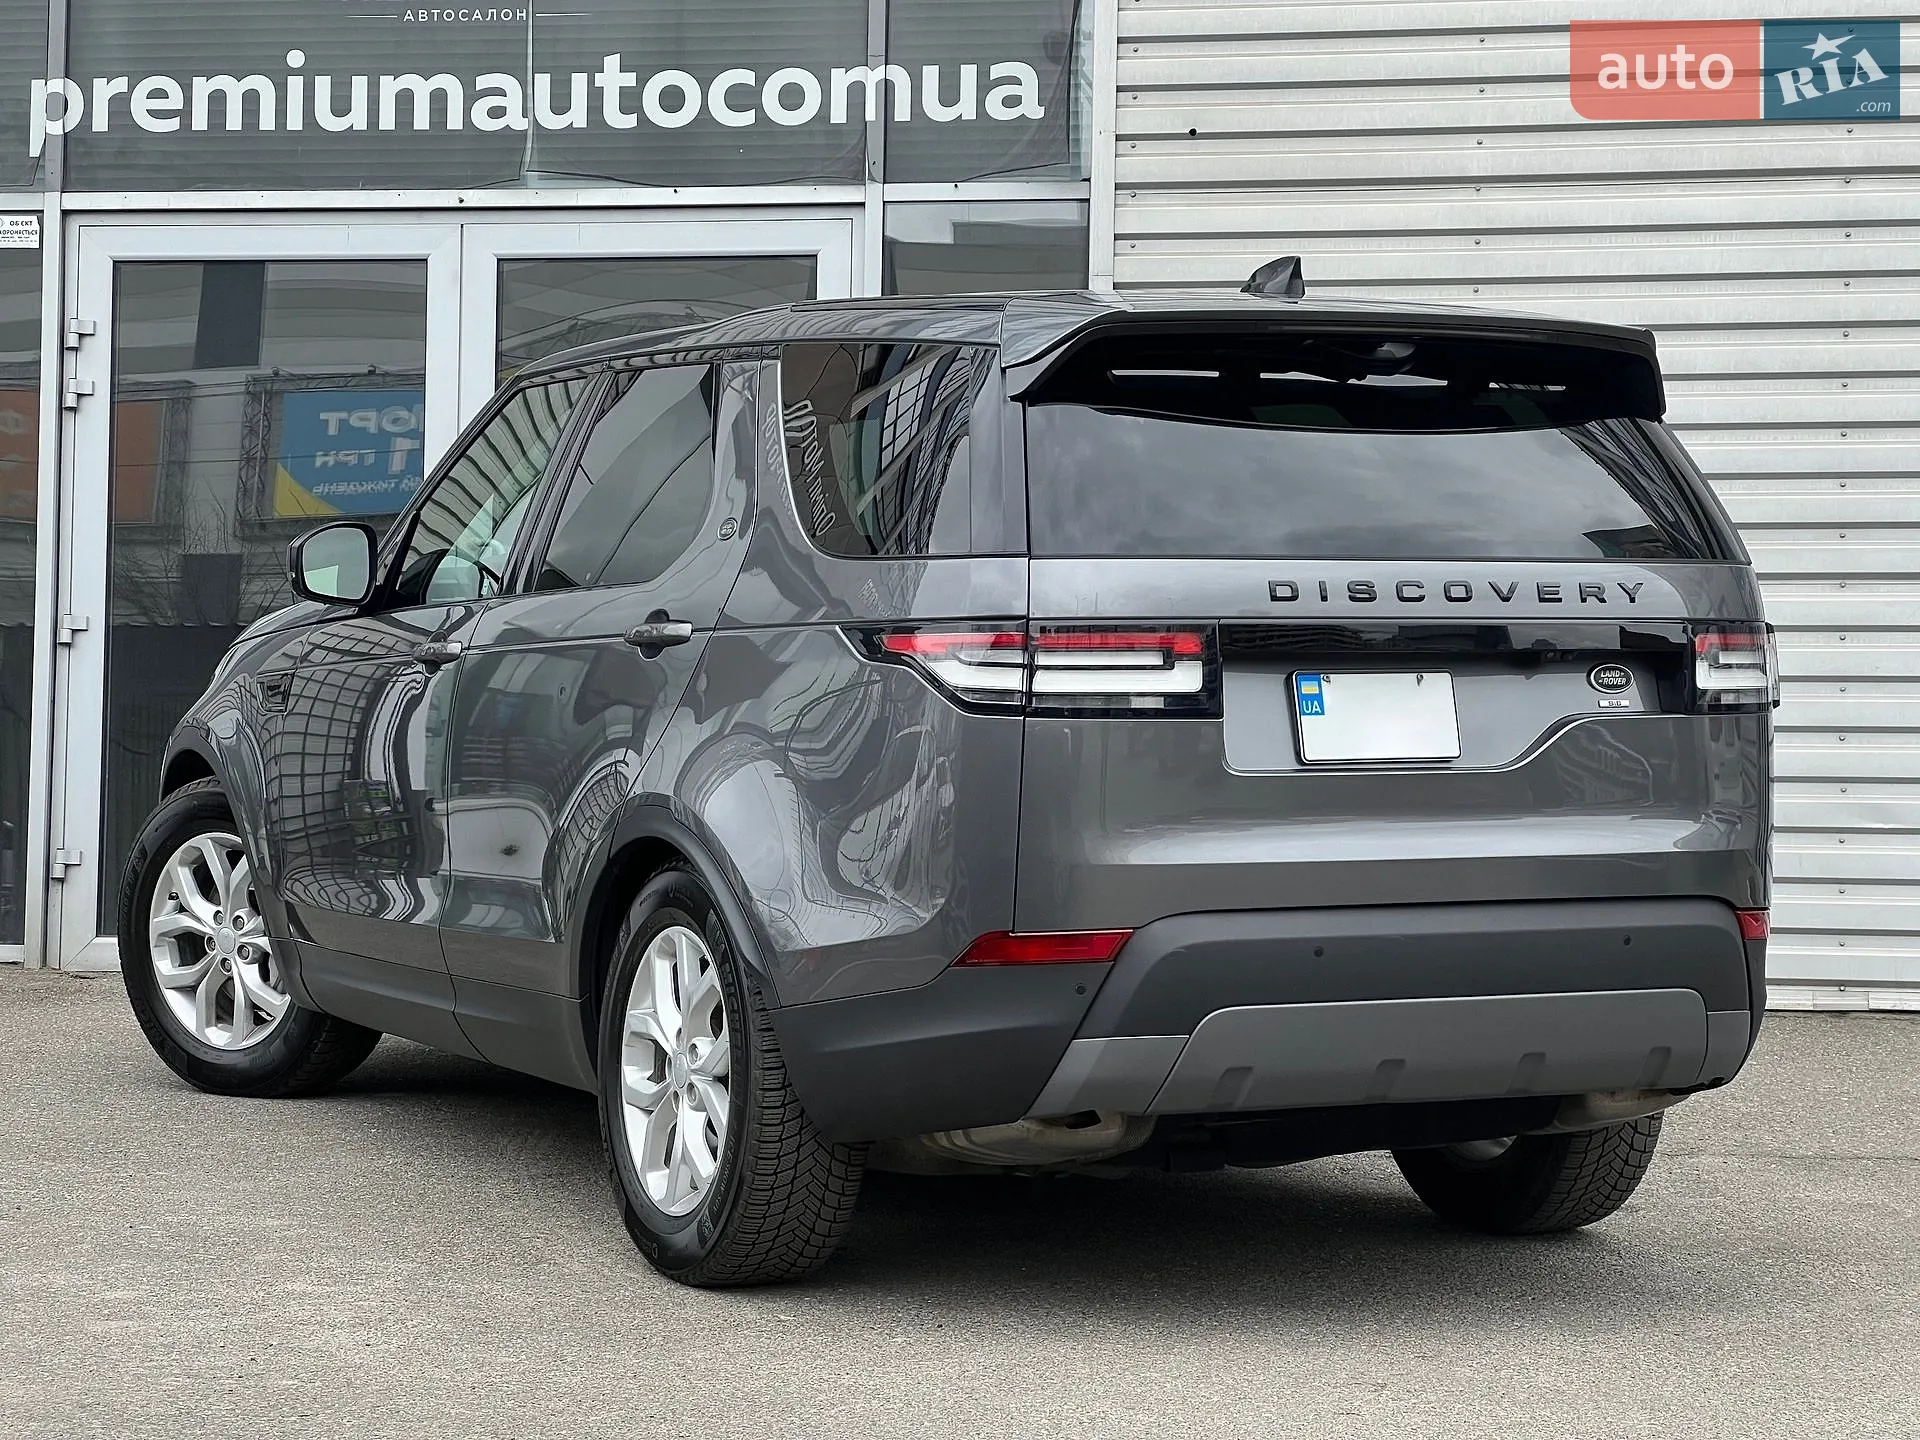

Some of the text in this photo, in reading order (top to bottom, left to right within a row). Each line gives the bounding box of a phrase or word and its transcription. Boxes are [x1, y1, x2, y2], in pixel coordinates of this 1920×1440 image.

[403, 8, 527, 23] АВТОСАЛОН
[28, 48, 1046, 158] premiumautocomua
[1267, 579, 1645, 604] DISCOVERY
[1303, 699, 1322, 714] UA
